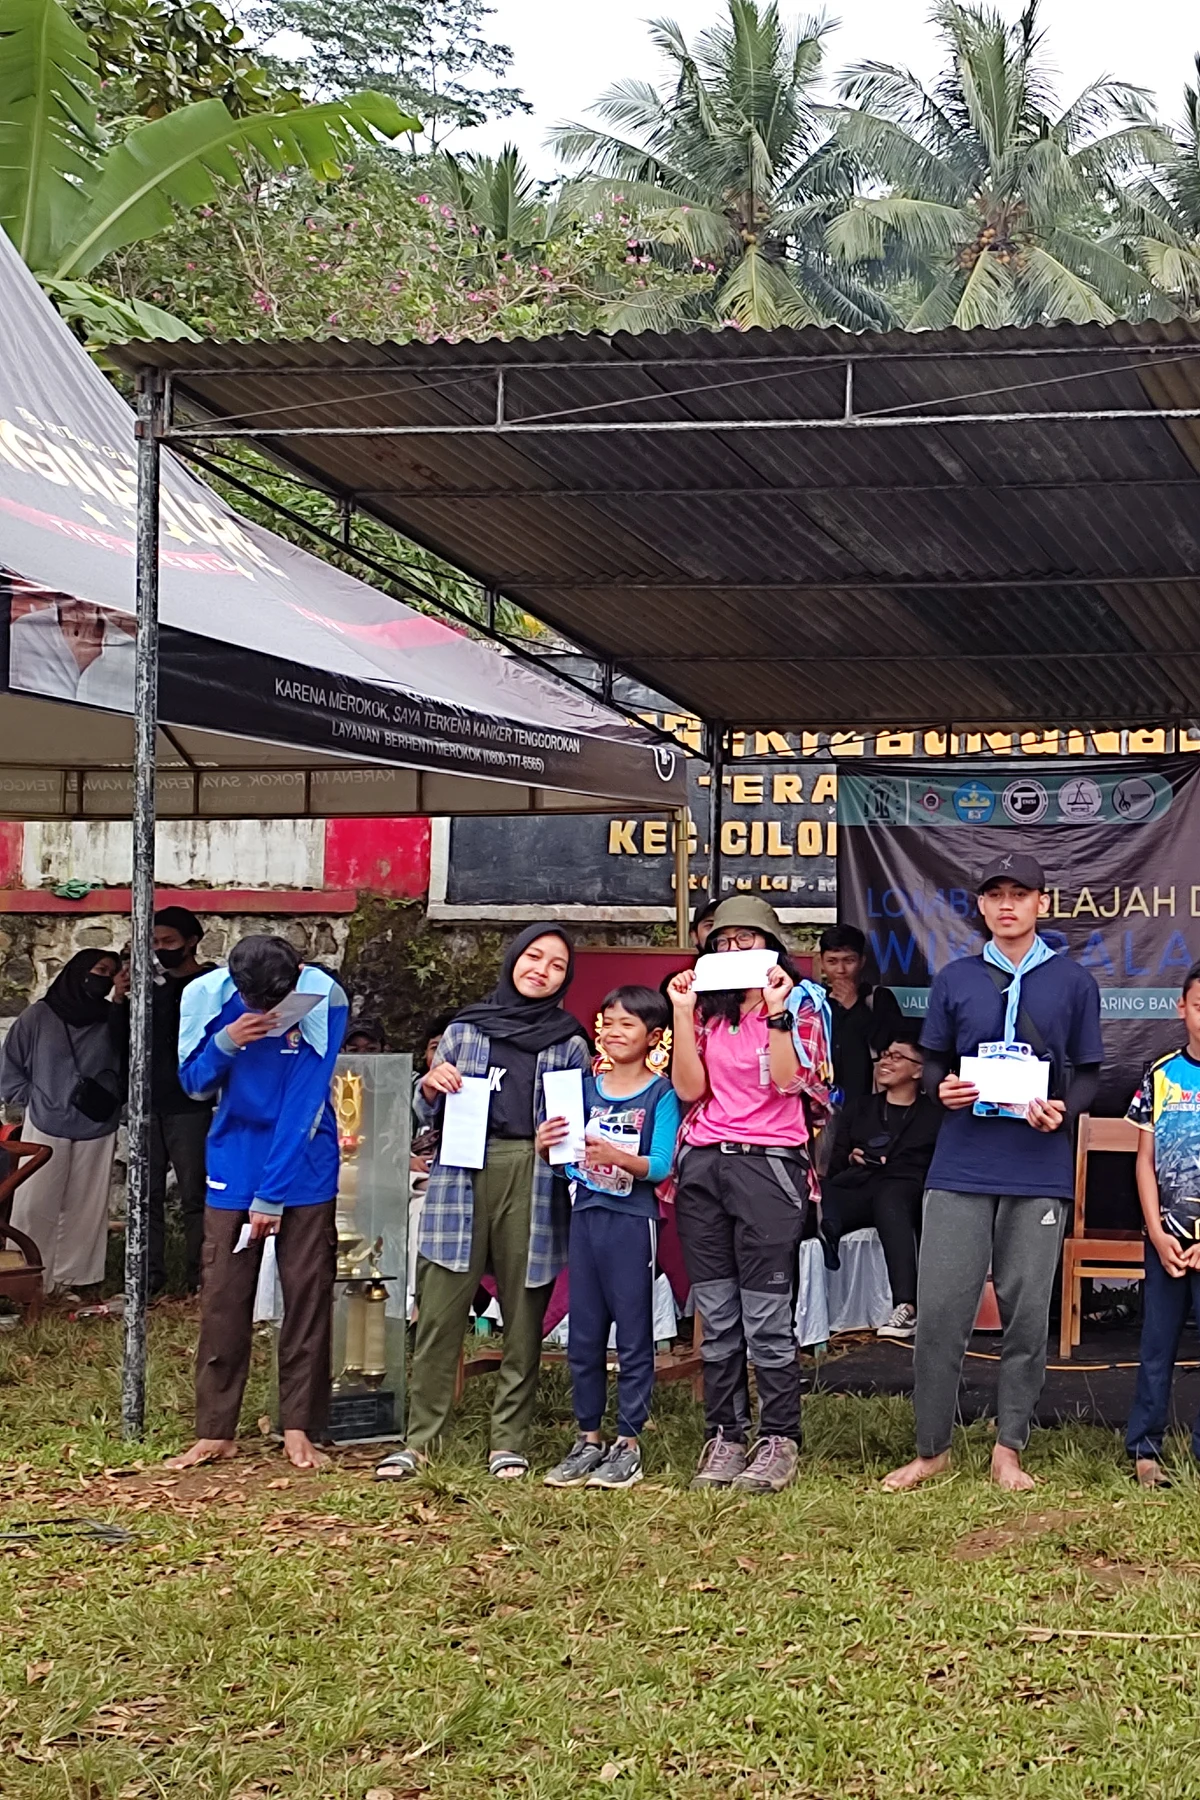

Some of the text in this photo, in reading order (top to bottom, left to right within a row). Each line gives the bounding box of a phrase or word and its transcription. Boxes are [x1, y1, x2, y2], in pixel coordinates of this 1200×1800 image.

[275, 678, 327, 707] KARENA
[329, 691, 391, 722] MEROKOK,
[393, 705, 422, 727] SAYA
[423, 712, 470, 736] TERKENA
[473, 721, 513, 743] KANKER
[514, 728, 581, 754] TENGGOROKAN
[332, 720, 380, 744] LAYANAN
